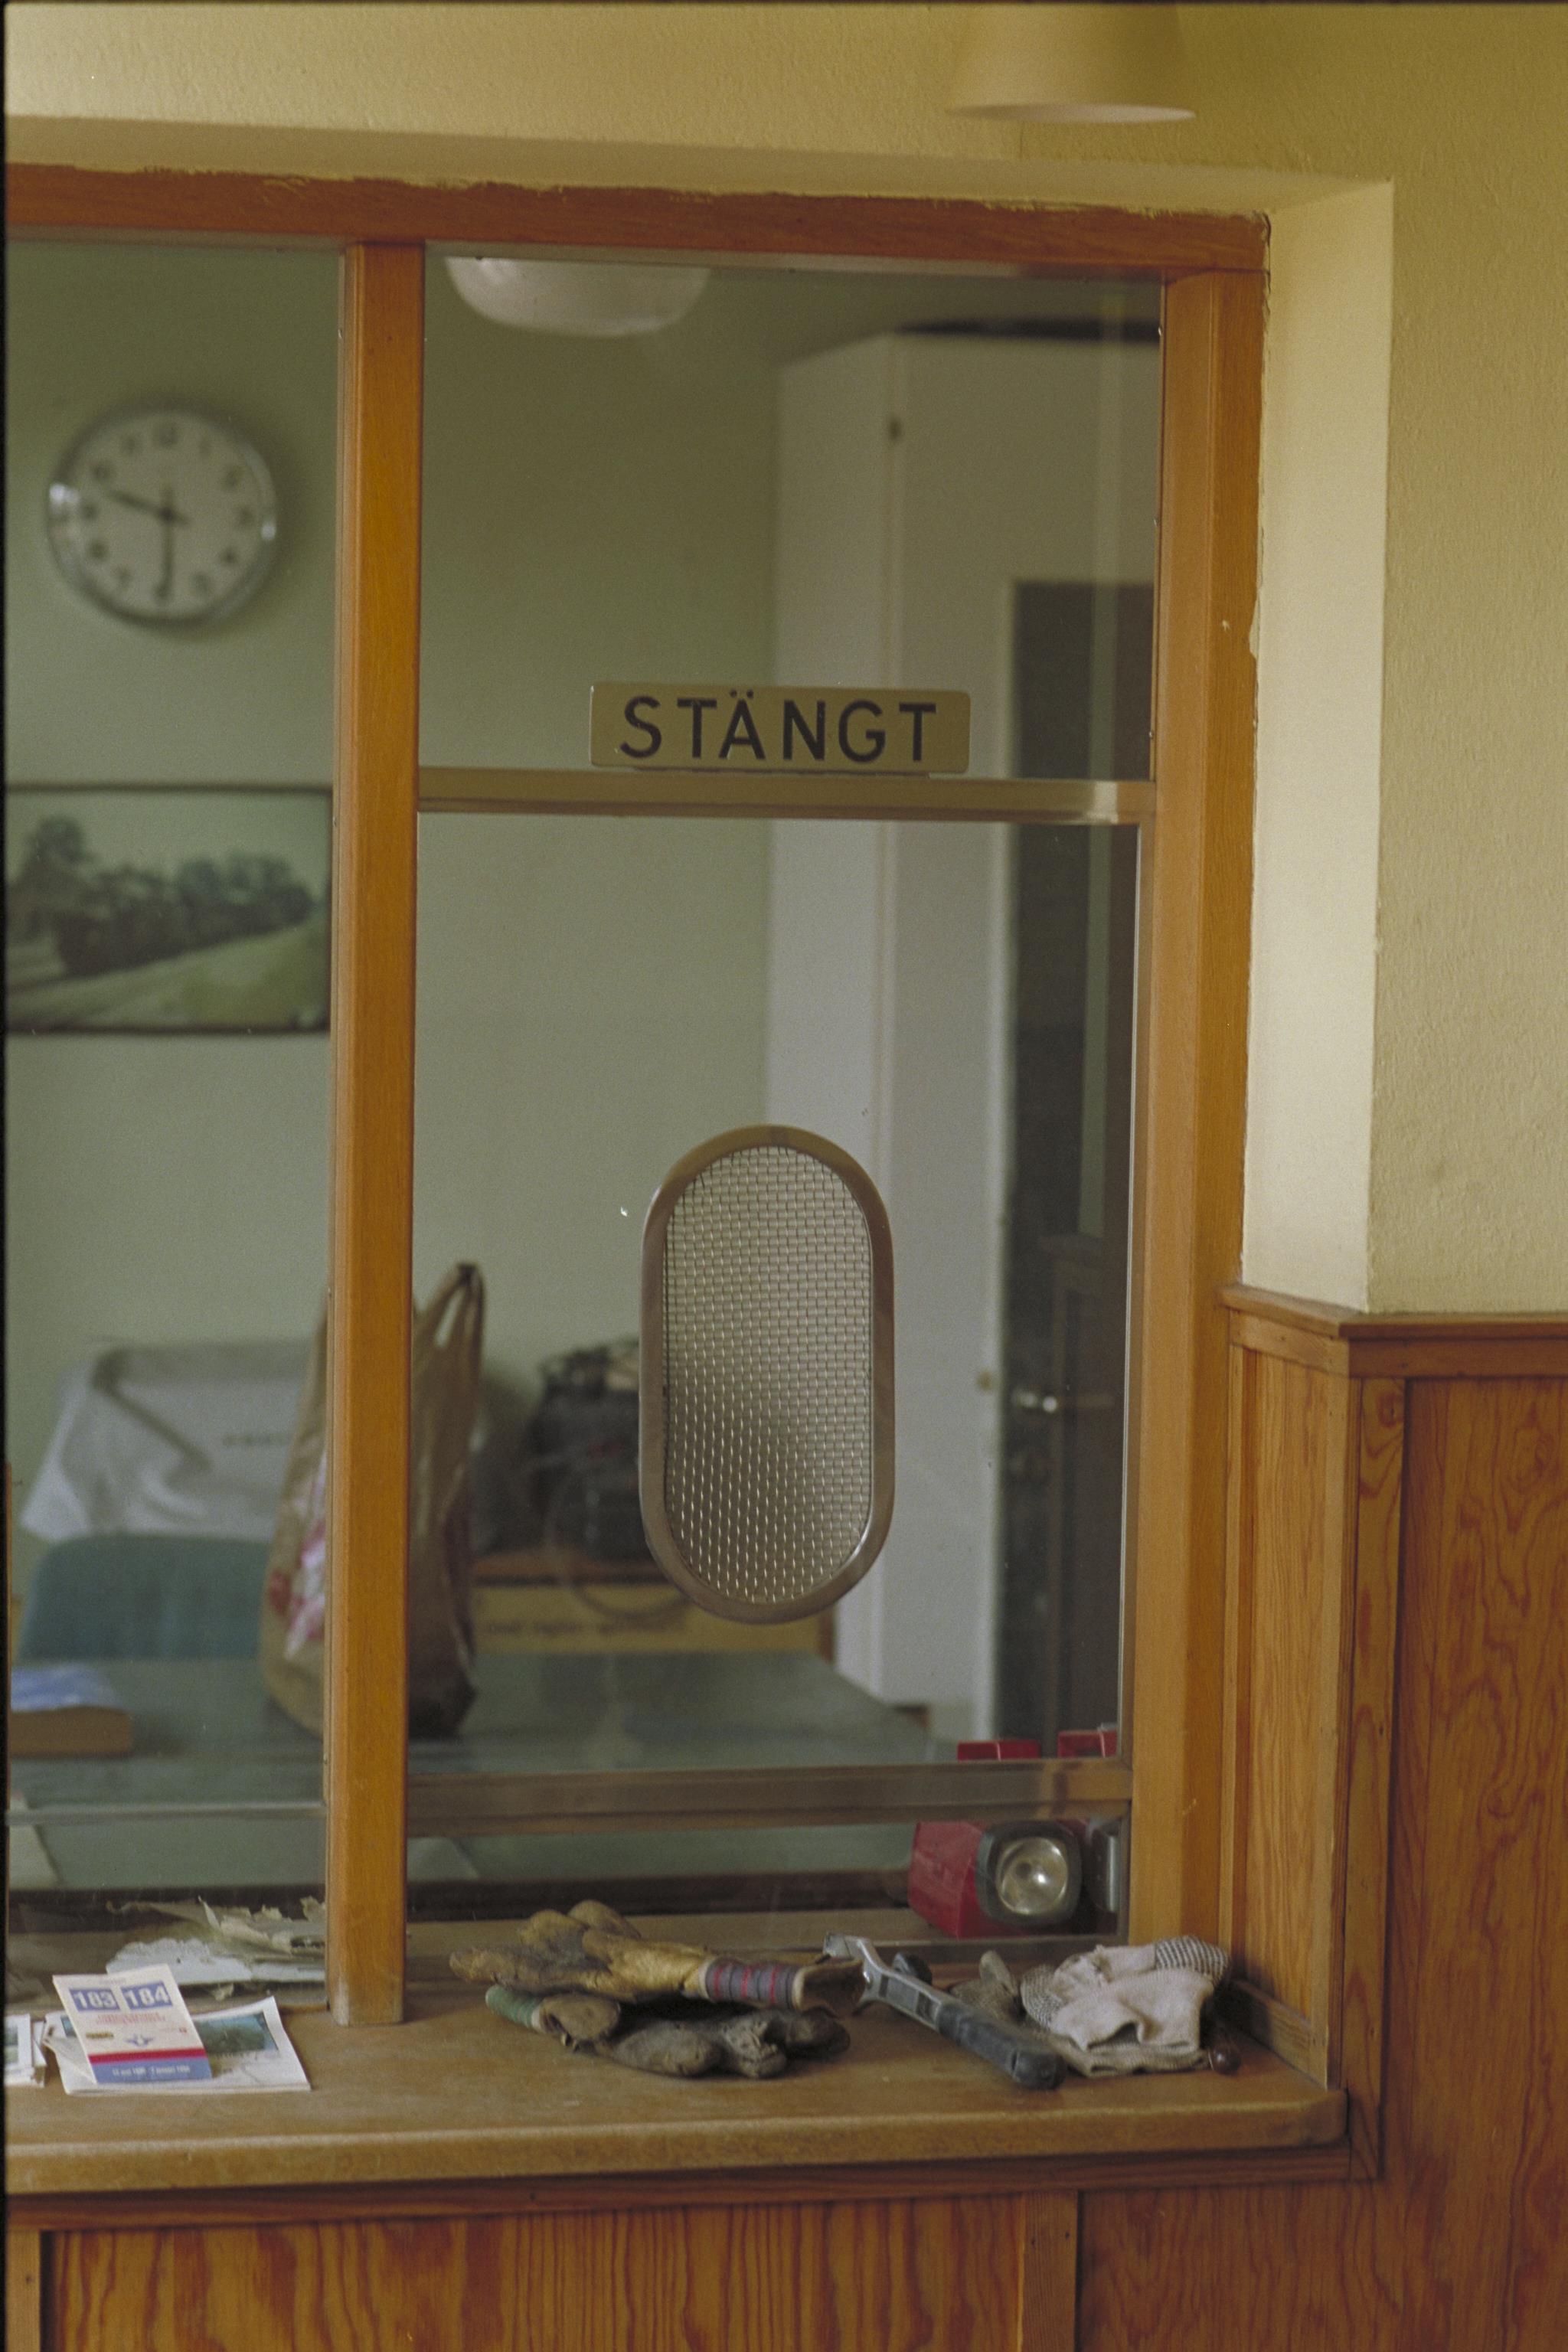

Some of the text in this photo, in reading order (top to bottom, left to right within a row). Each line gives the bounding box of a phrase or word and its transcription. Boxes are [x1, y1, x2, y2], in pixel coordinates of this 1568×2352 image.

[619, 689, 937, 763] STÄNGT
[73, 1984, 169, 2009] 183 184
